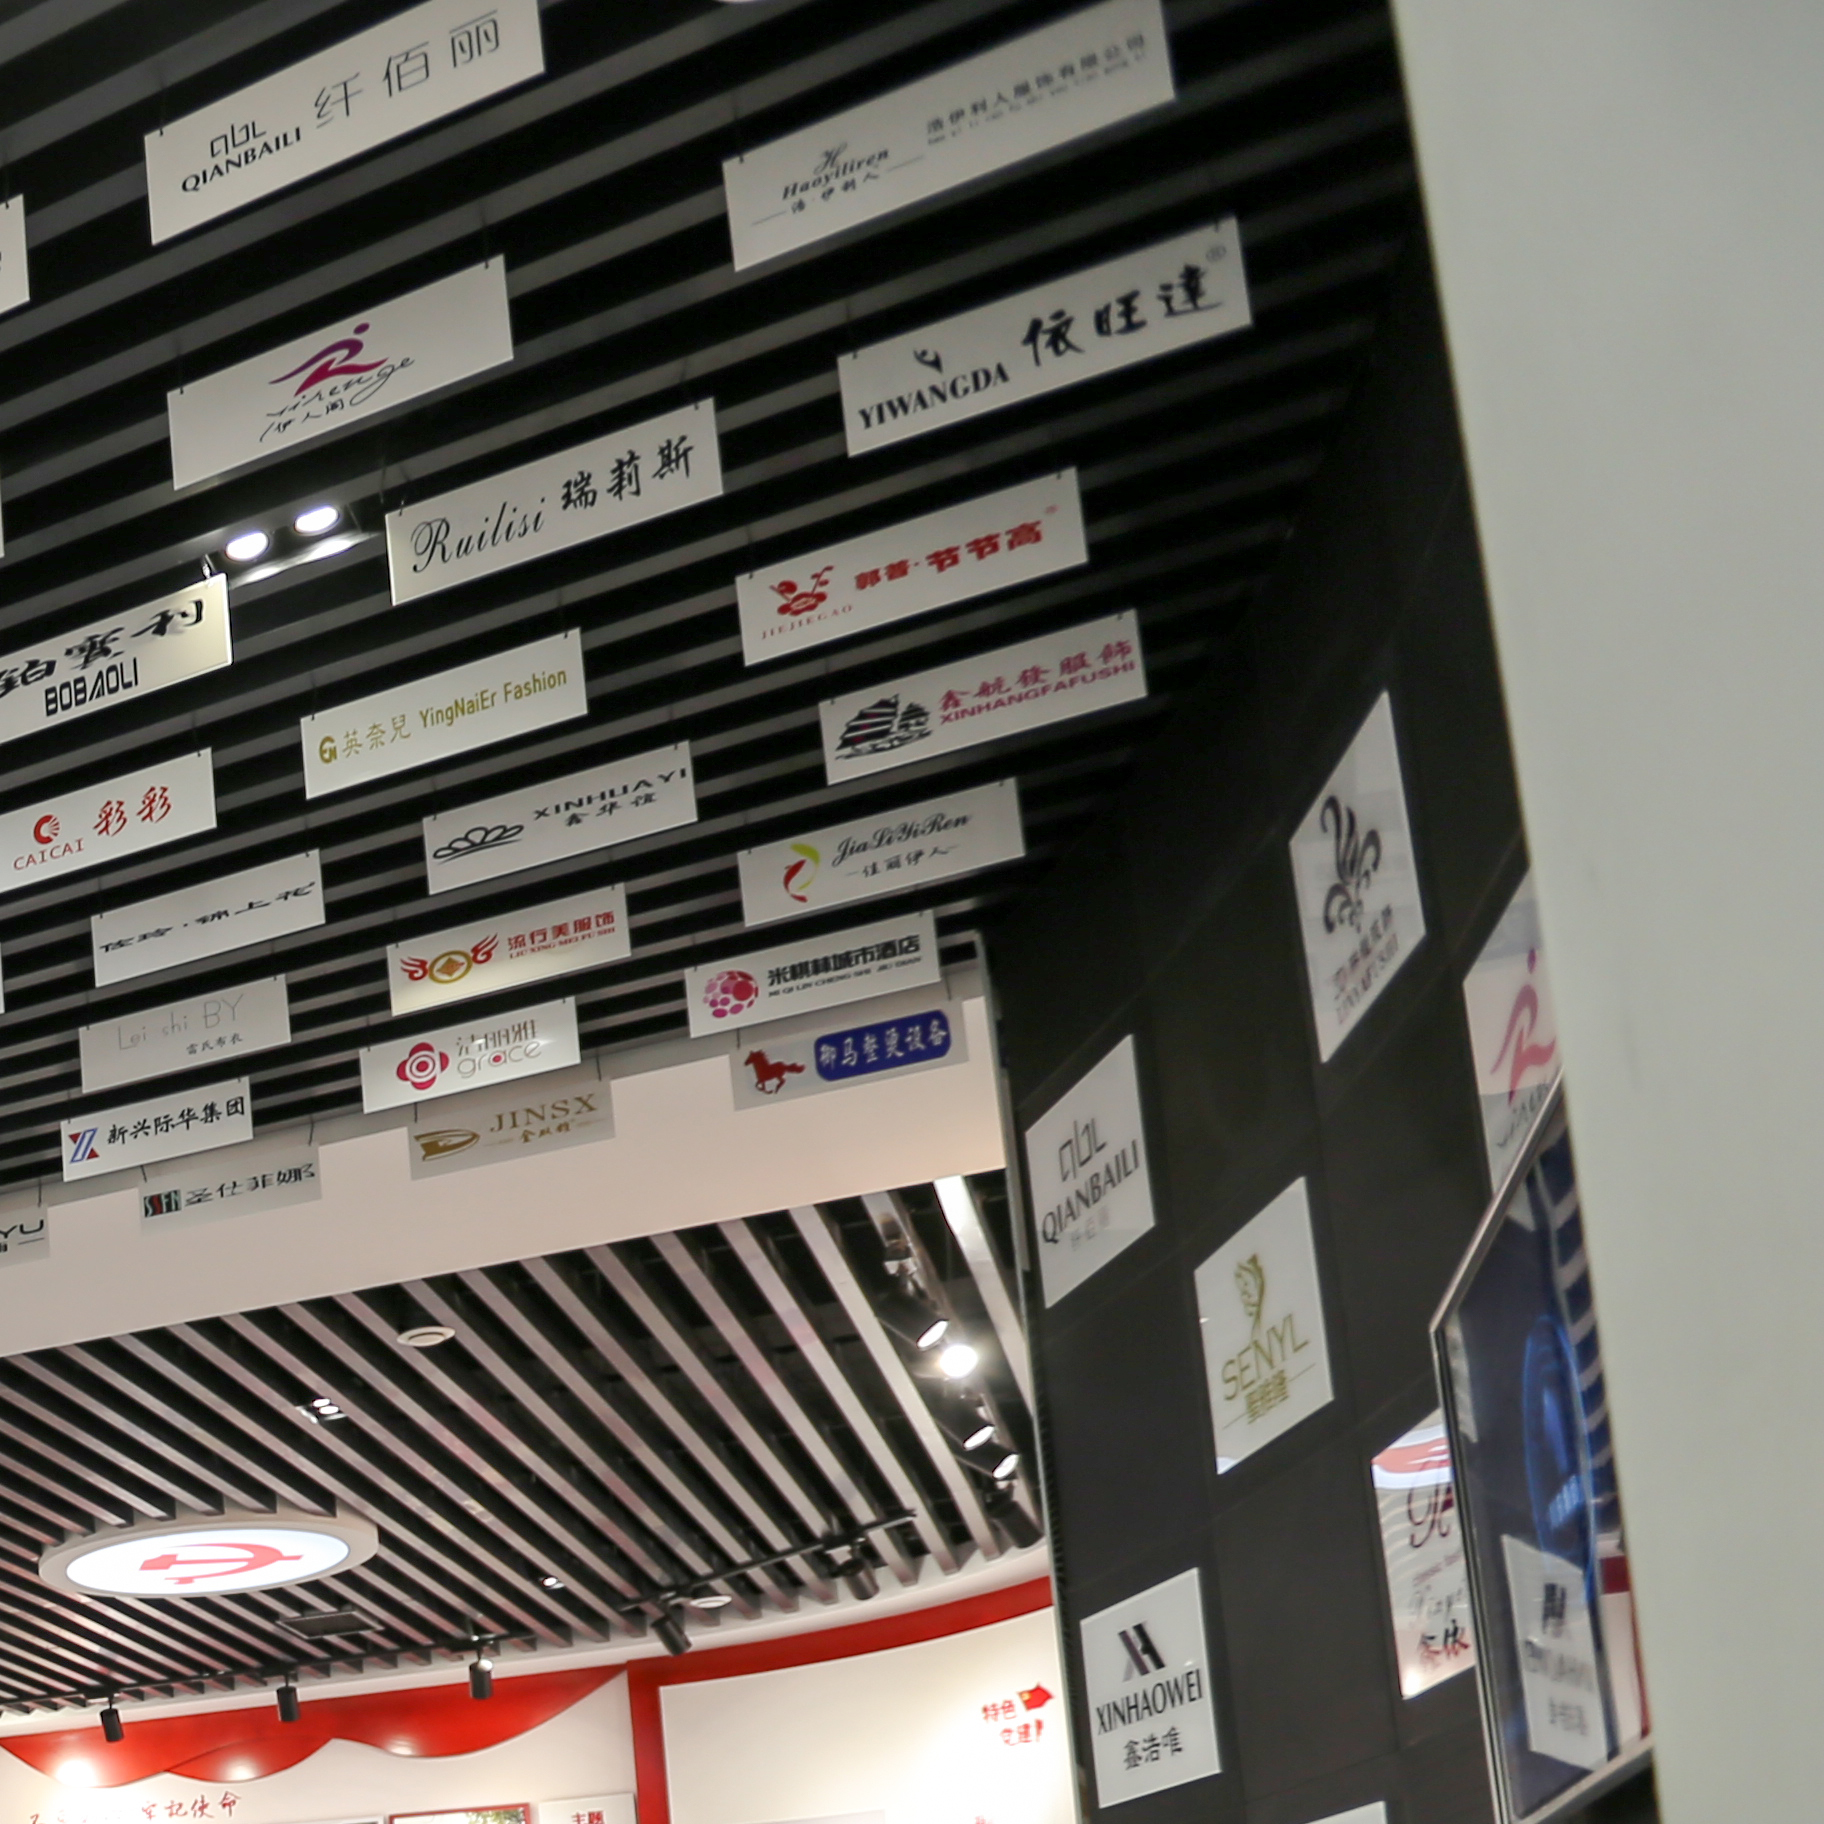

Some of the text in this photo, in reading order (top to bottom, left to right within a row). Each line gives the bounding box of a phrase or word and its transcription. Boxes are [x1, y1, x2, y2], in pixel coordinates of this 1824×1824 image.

[315, 9, 501, 128] 纤佰丽
[181, 126, 302, 193] QIANBAILI
[858, 361, 1010, 430] YIWANGDA
[410, 434, 694, 574] Ruilisi 瑞莉斯
[761, 605, 853, 641] JIEJIEGAO
[44, 658, 139, 717] BOBAOLI
[419, 689, 497, 731] YingNaiEr
[503, 669, 567, 701] Fashion
[940, 660, 1136, 725] XINHANGFAFUSHI
[93, 786, 173, 837] 彩彩
[533, 768, 687, 820] XINHUAYI
[12, 837, 86, 870] CAICAI
[508, 911, 615, 950] 流行美服饰
[457, 1041, 543, 1078] grace
[107, 1096, 246, 1145] 新兴际华集团
[490, 1093, 597, 1133] JINSX
[1042, 1139, 1140, 1245] QIANBAILI
[1221, 1314, 1309, 1402] SENYL
[1097, 1668, 1203, 1735] XINHAOWEI
